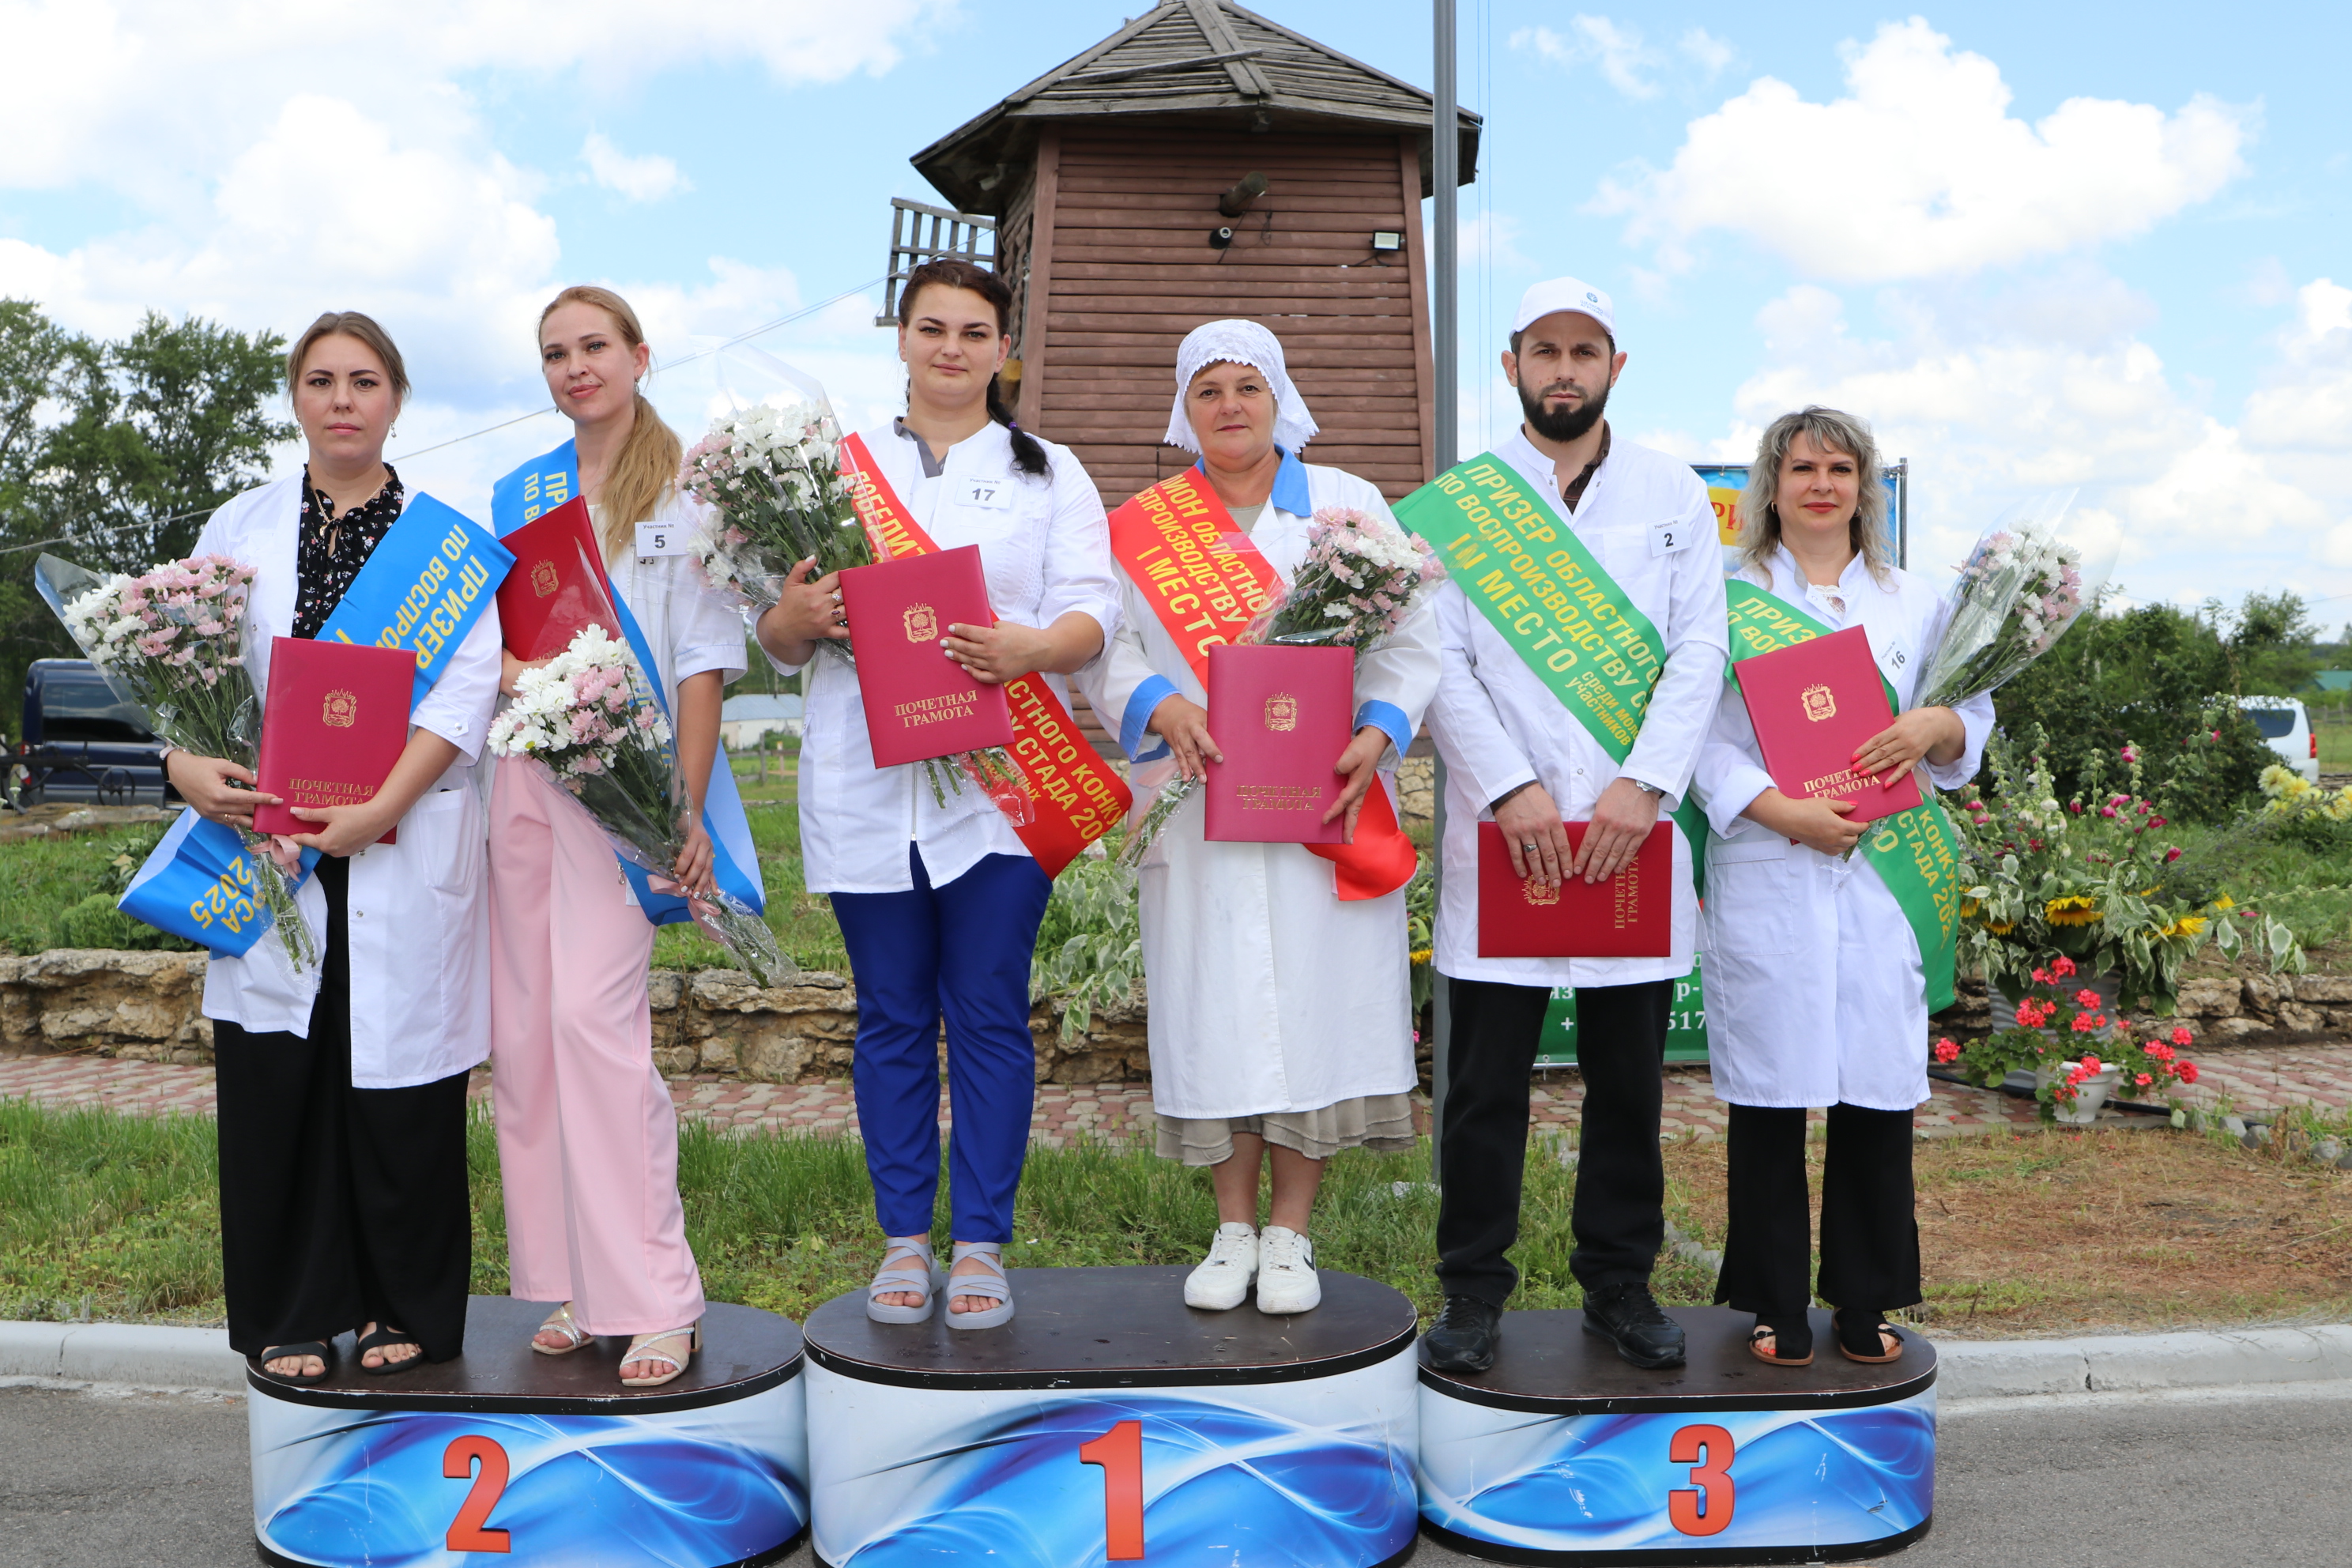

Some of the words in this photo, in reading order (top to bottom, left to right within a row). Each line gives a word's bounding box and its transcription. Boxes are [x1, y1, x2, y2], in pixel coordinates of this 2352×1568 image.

[524, 473, 540, 502] ПО
[545, 471, 568, 513] ПР
[972, 488, 996, 501] 17
[524, 503, 540, 525] В
[441, 524, 470, 561] ПО
[654, 534, 665, 549] 5
[1134, 486, 1249, 623] СПРОИЗВОДСТВУ
[1664, 532, 1674, 548] 2
[1434, 472, 1466, 495] ПО
[1455, 493, 1640, 686] ВОСПРОИЗВОДСТВУ
[1464, 463, 1557, 543] ПРИЗЕР
[1546, 550, 1660, 684] ОБЛАСТНОГО
[375, 556, 450, 650] ВОСПРО
[413, 554, 489, 669] ПРИЗЕР
[1476, 568, 1578, 673] МЕСТО
[1891, 650, 1905, 670] 16
[894, 689, 978, 717] ПОЧЕТНАЯ
[1581, 671, 1619, 709] среди
[903, 704, 974, 728] ГРАМОТА
[1004, 679, 1078, 763] СТНОГО
[1565, 677, 1631, 746] участников
[288, 778, 374, 797] ПОЧЕТНАЯ
[293, 791, 365, 806] ГРАМОТА
[1016, 737, 1080, 811] СТАДА
[1069, 807, 1106, 846] 20
[1236, 785, 1321, 798] ПОЧЕТНАЯ
[1803, 767, 1862, 793] ПОЧЕТ
[1813, 775, 1881, 798] ГРАМОТА
[1242, 797, 1314, 810] ГРАМОТА
[1897, 811, 1939, 888] СТАДА
[190, 855, 252, 929] 2025
[1628, 855, 1639, 922] ГРАМОТА
[443, 1434, 511, 1554] 2
[1079, 1419, 1145, 1562] 1
[1668, 1423, 1736, 1537] 3
